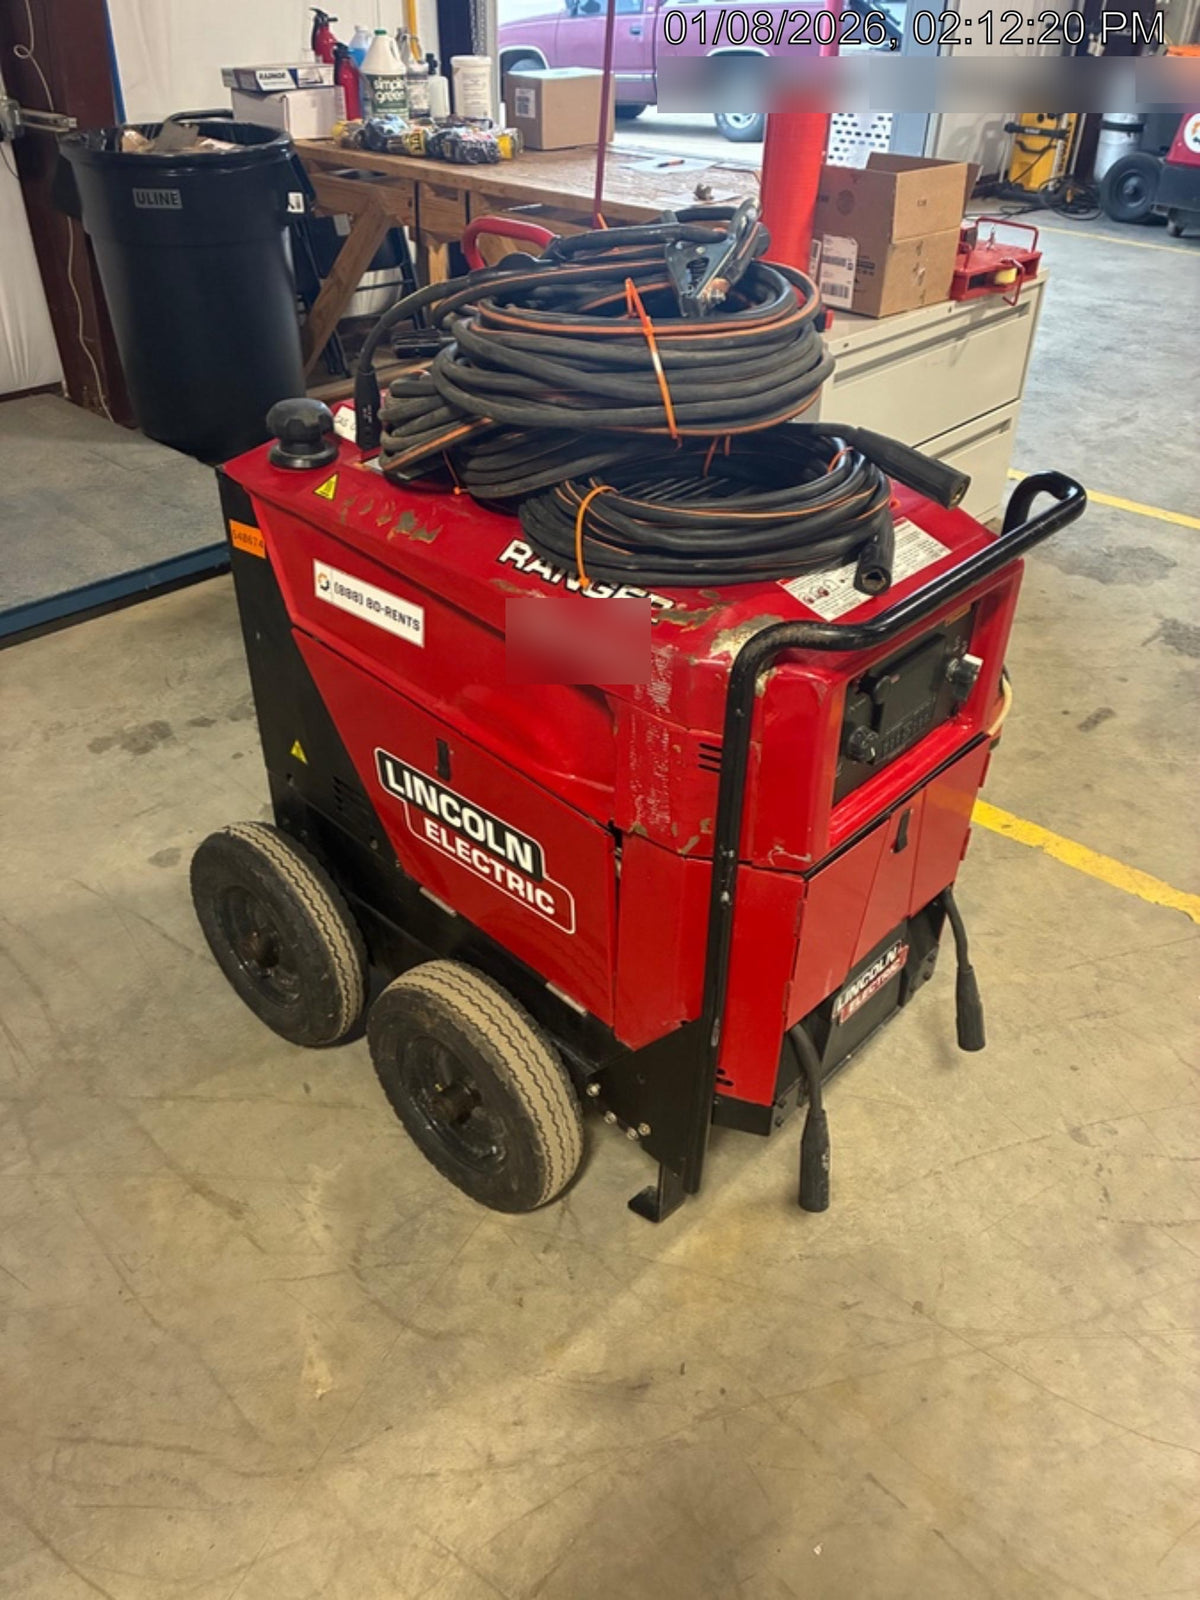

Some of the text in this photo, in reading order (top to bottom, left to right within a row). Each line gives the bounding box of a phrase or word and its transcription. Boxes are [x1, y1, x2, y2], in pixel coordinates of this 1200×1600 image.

[373, 75, 405, 92] simple
[375, 91, 405, 104] green
[135, 191, 179, 206] ULINE
[385, 759, 534, 874] LINCOLN
[423, 817, 556, 915] ELECTRIC
